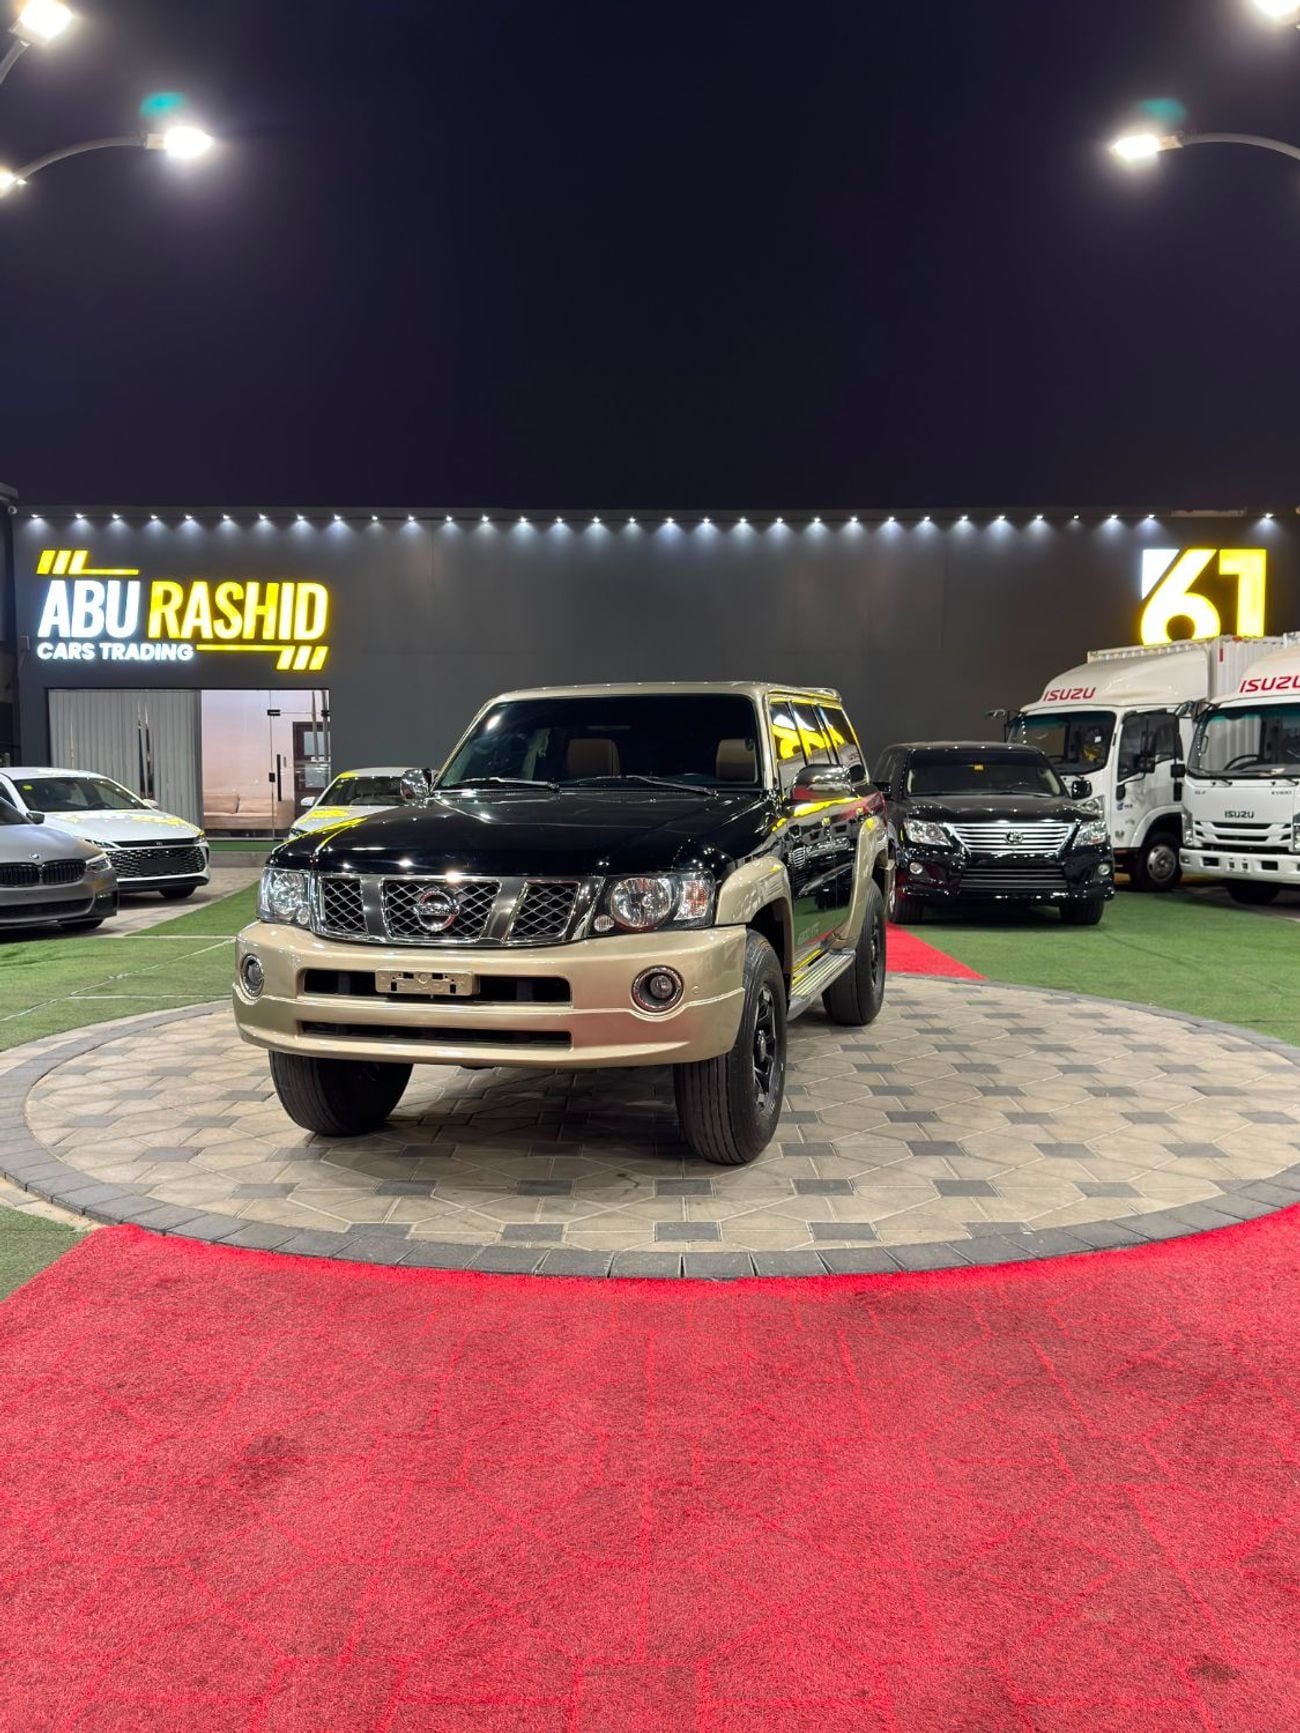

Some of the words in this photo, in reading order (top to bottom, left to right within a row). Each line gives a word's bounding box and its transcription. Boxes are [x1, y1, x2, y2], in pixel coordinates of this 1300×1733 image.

[1140, 548, 1267, 646] 61
[37, 579, 141, 639] ABU
[147, 580, 329, 640] RASHID
[36, 642, 96, 661] CARS
[99, 642, 195, 662] TRADING
[1043, 686, 1097, 702] ISUZU
[1224, 810, 1255, 819] ISUZU
